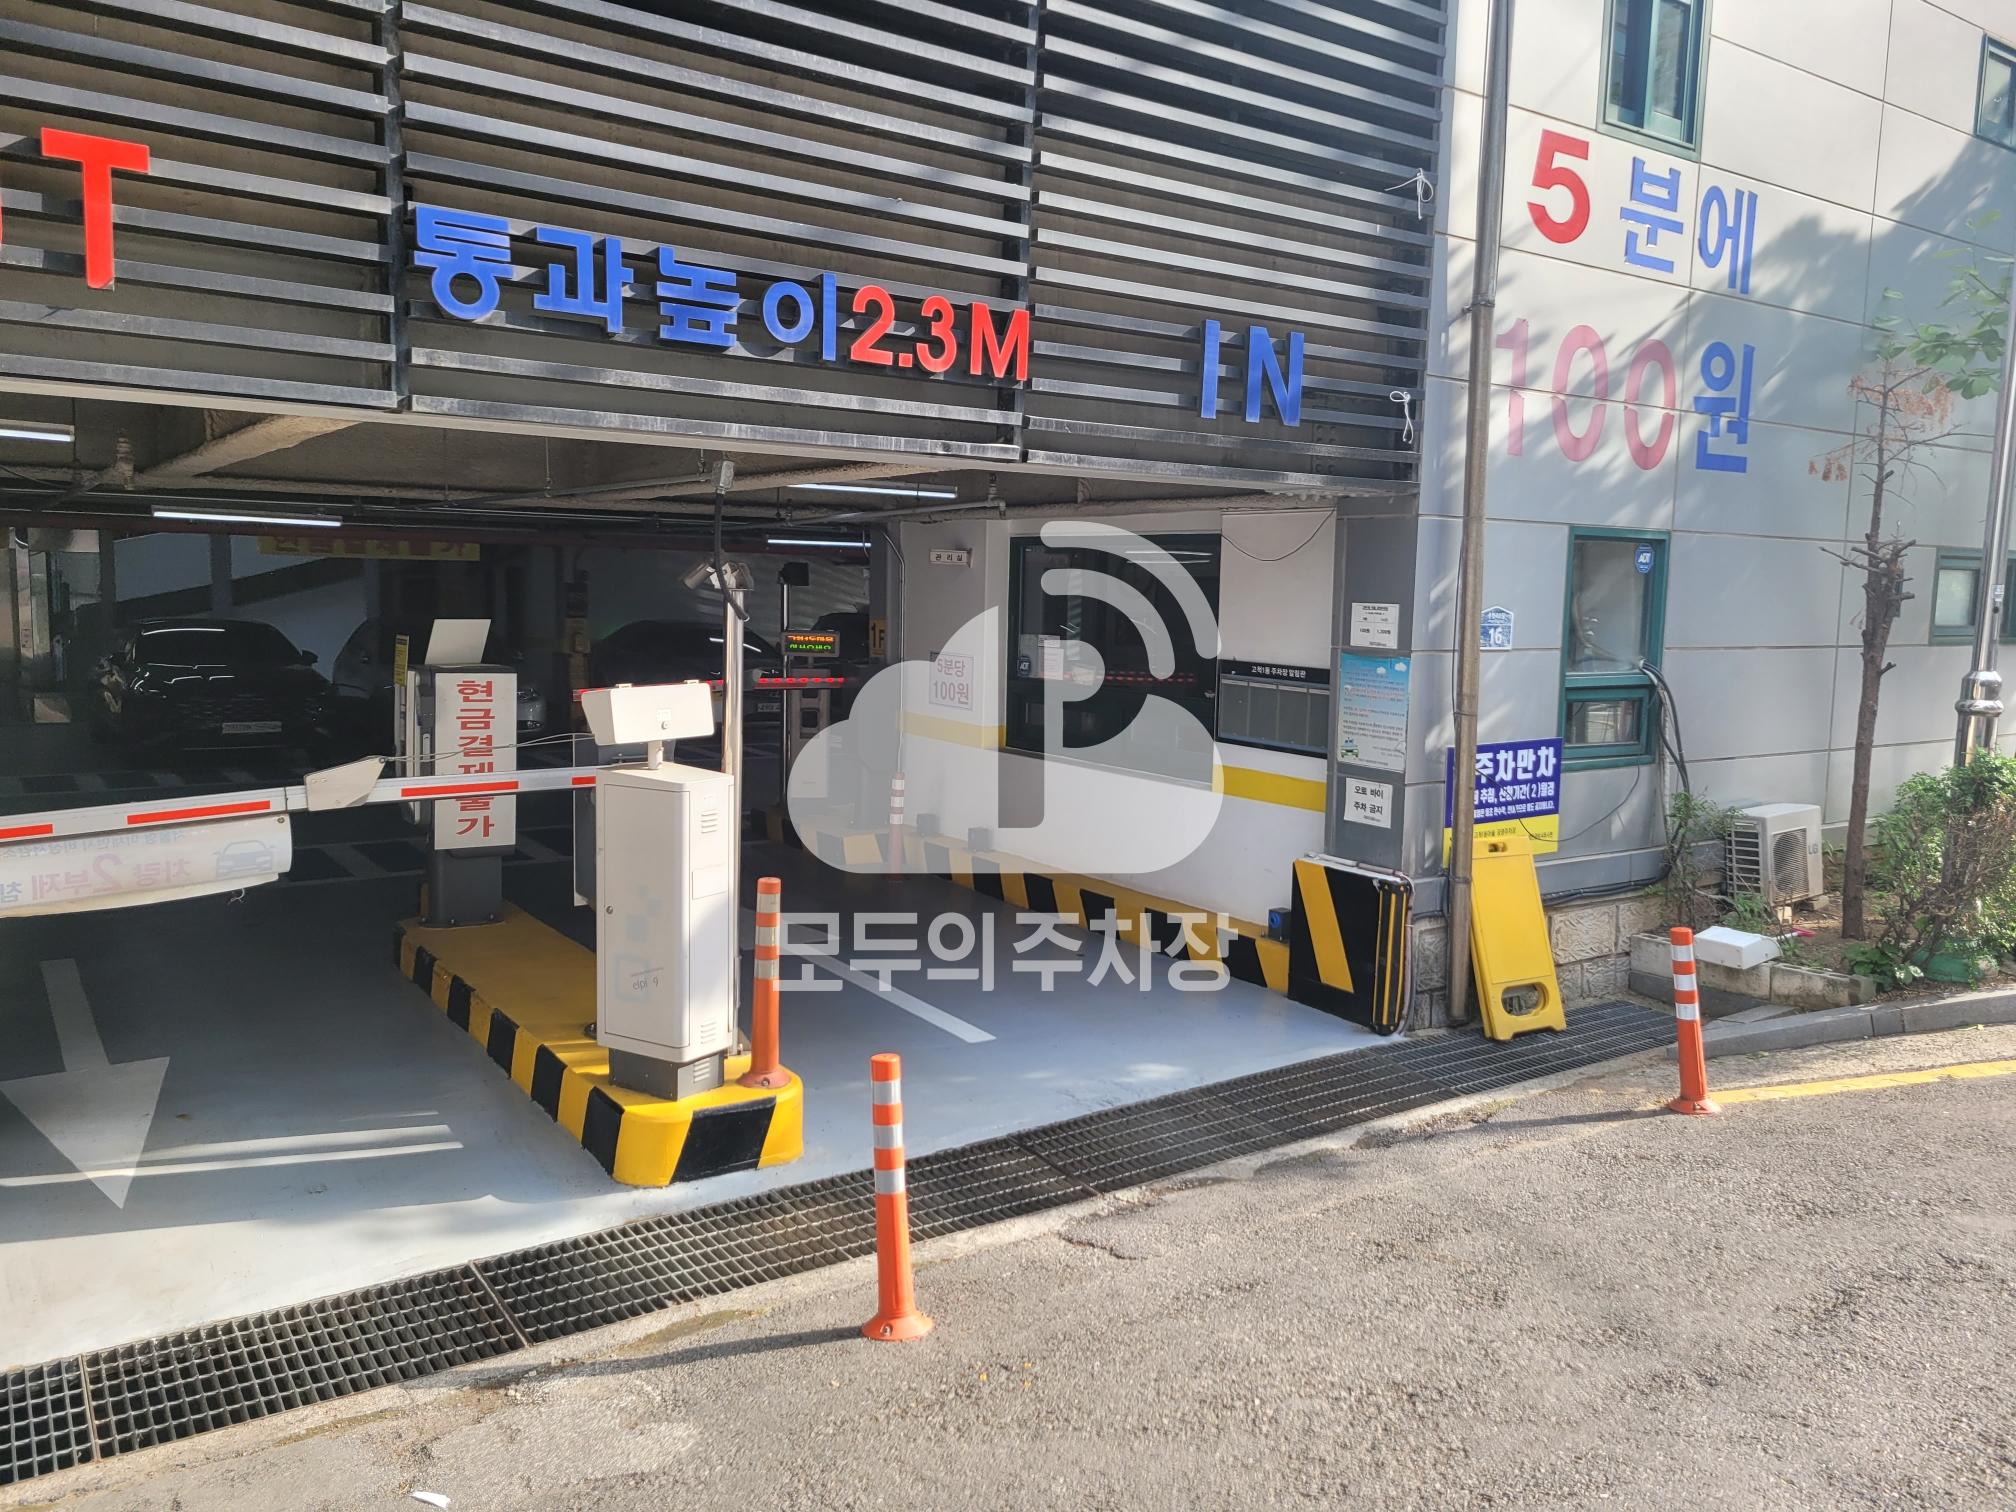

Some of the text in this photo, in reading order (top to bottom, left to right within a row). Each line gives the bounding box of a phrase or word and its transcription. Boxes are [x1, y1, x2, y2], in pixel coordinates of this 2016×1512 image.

[0, 127, 149, 289] T
[1199, 319, 1304, 426] IN
[1496, 317, 1755, 473] 100원
[934, 680, 969, 705] 100원
[1353, 801, 1383, 815] 주차 금지
